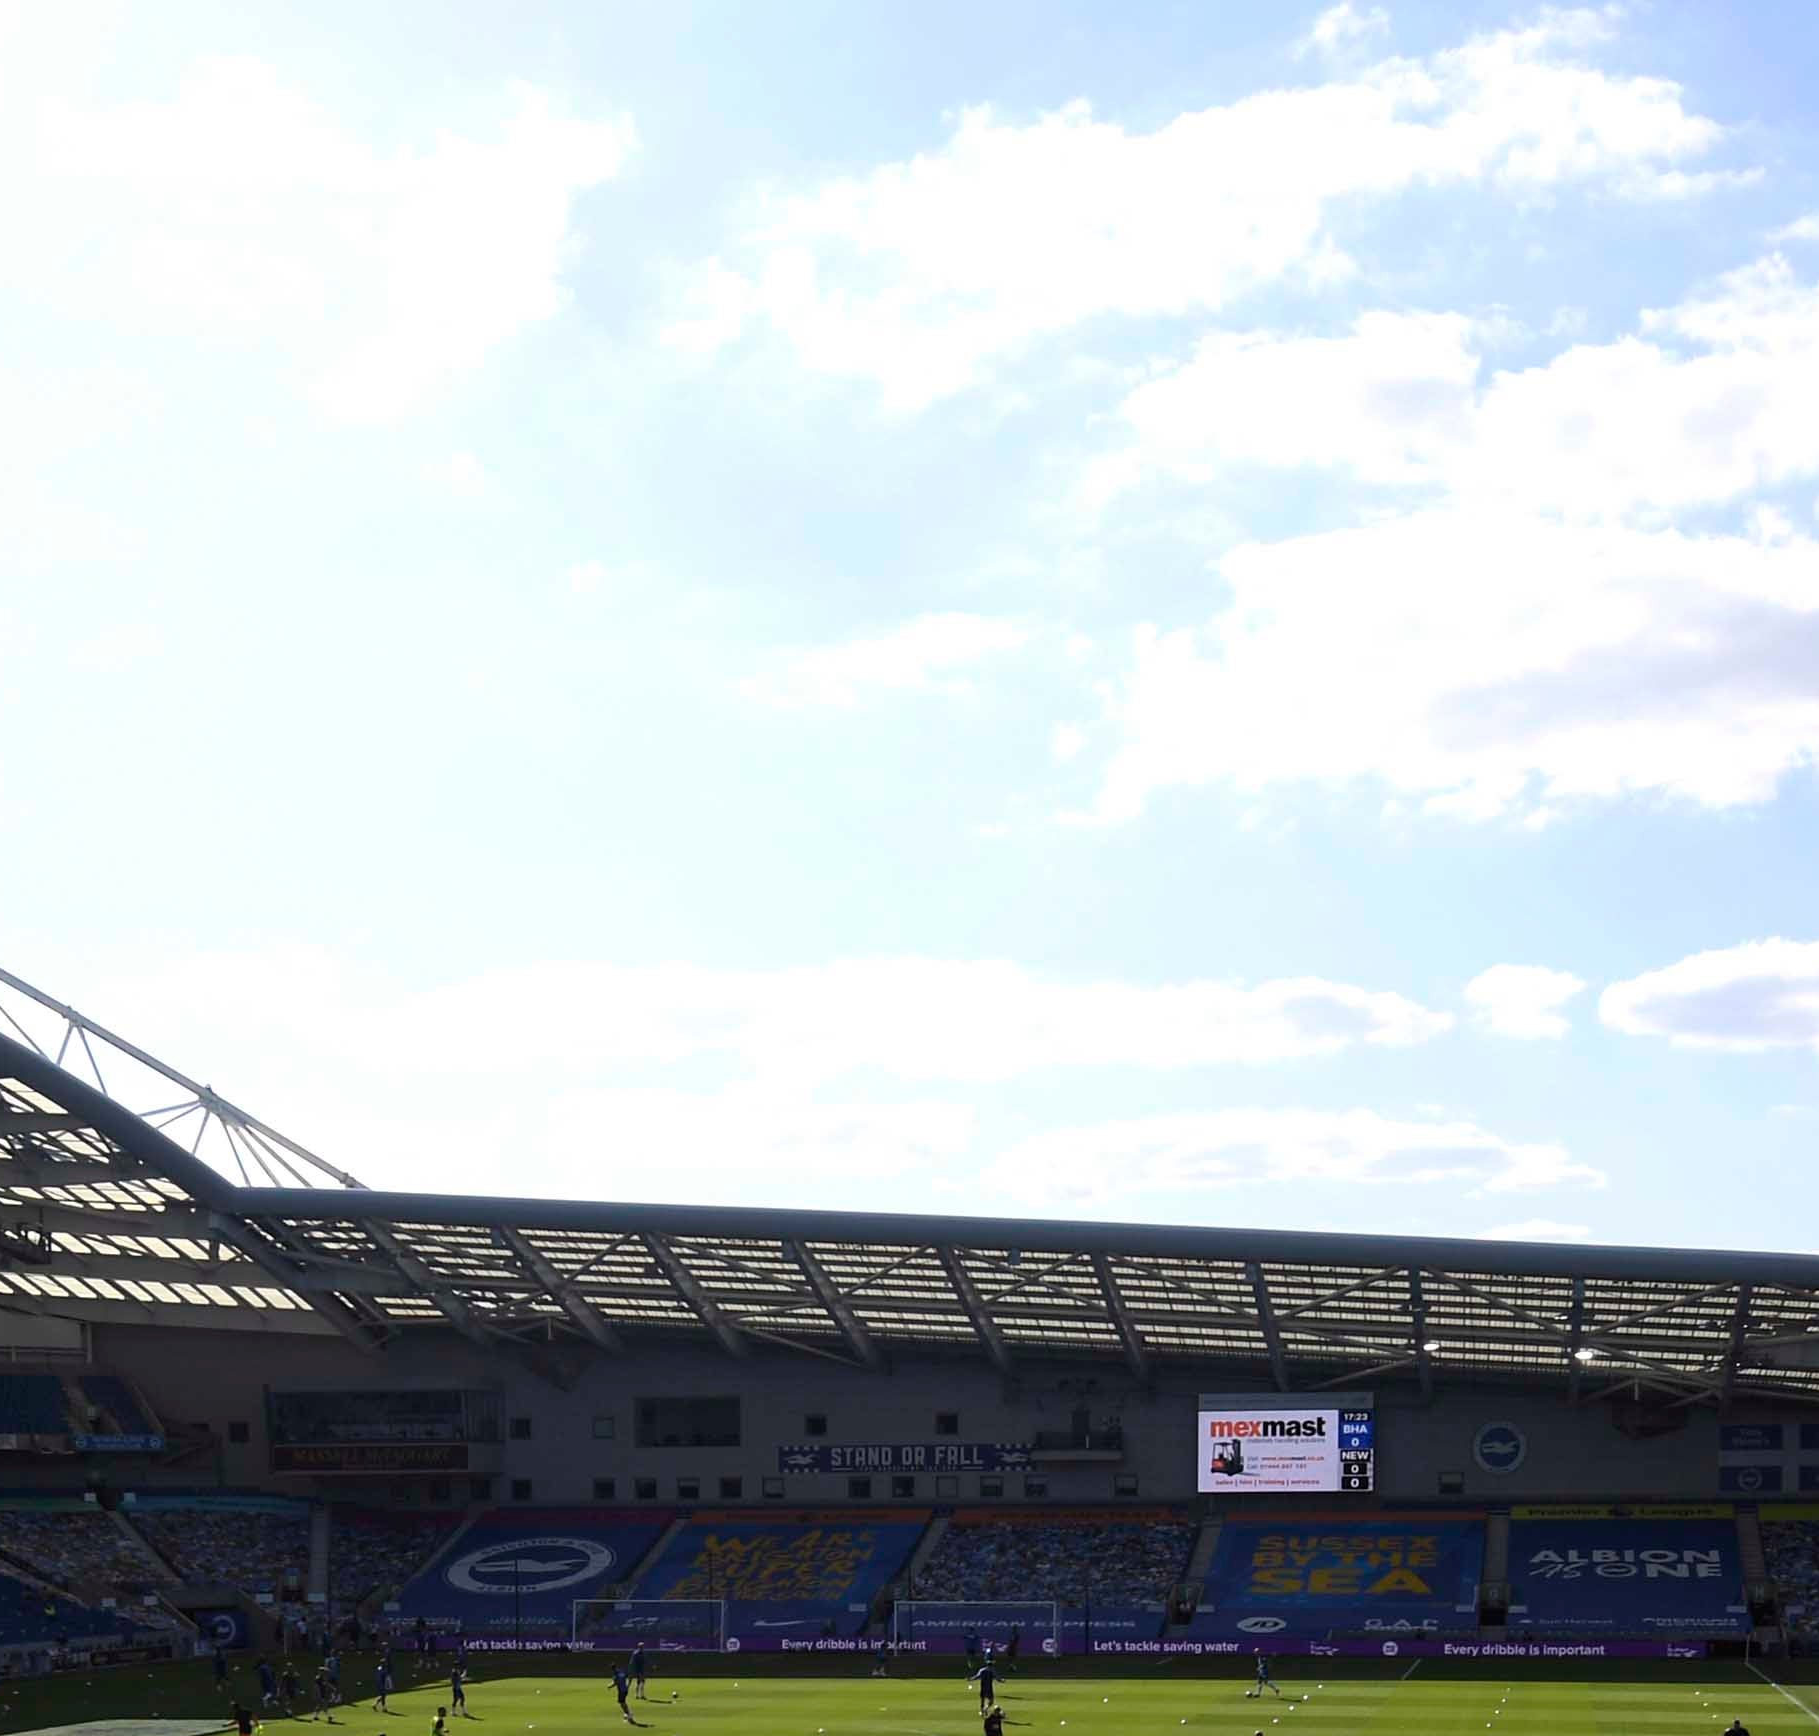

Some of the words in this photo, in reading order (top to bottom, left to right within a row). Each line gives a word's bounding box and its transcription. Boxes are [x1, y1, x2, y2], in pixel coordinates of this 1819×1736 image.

[1343, 1412, 1368, 1421] 17:23
[1210, 1416, 1326, 1438] mexmast
[1343, 1424, 1368, 1435] BHA
[830, 1446, 893, 1467] STAND
[901, 1446, 925, 1467] OR
[935, 1446, 984, 1467] FALL
[1341, 1451, 1369, 1461] NEW
[1351, 1465, 1360, 1474] 0
[1350, 1478, 1360, 1489] 0
[1259, 1535, 1438, 1552] SUSSEX
[1251, 1551, 1320, 1568] BY
[1340, 1551, 1438, 1568] THE
[1529, 1549, 1721, 1564] ALBION
[1250, 1567, 1433, 1595] SEA
[781, 1638, 814, 1652] Every
[815, 1638, 856, 1651] dribble
[858, 1638, 868, 1651] is
[1093, 1640, 1123, 1652] Let's
[1124, 1640, 1161, 1652] tackle
[1163, 1641, 1203, 1655] saving
[1204, 1642, 1240, 1653] water
[1443, 1643, 1481, 1657] Every
[1482, 1643, 1525, 1656] dribble
[1528, 1644, 1540, 1656] is
[1542, 1644, 1605, 1659] important
